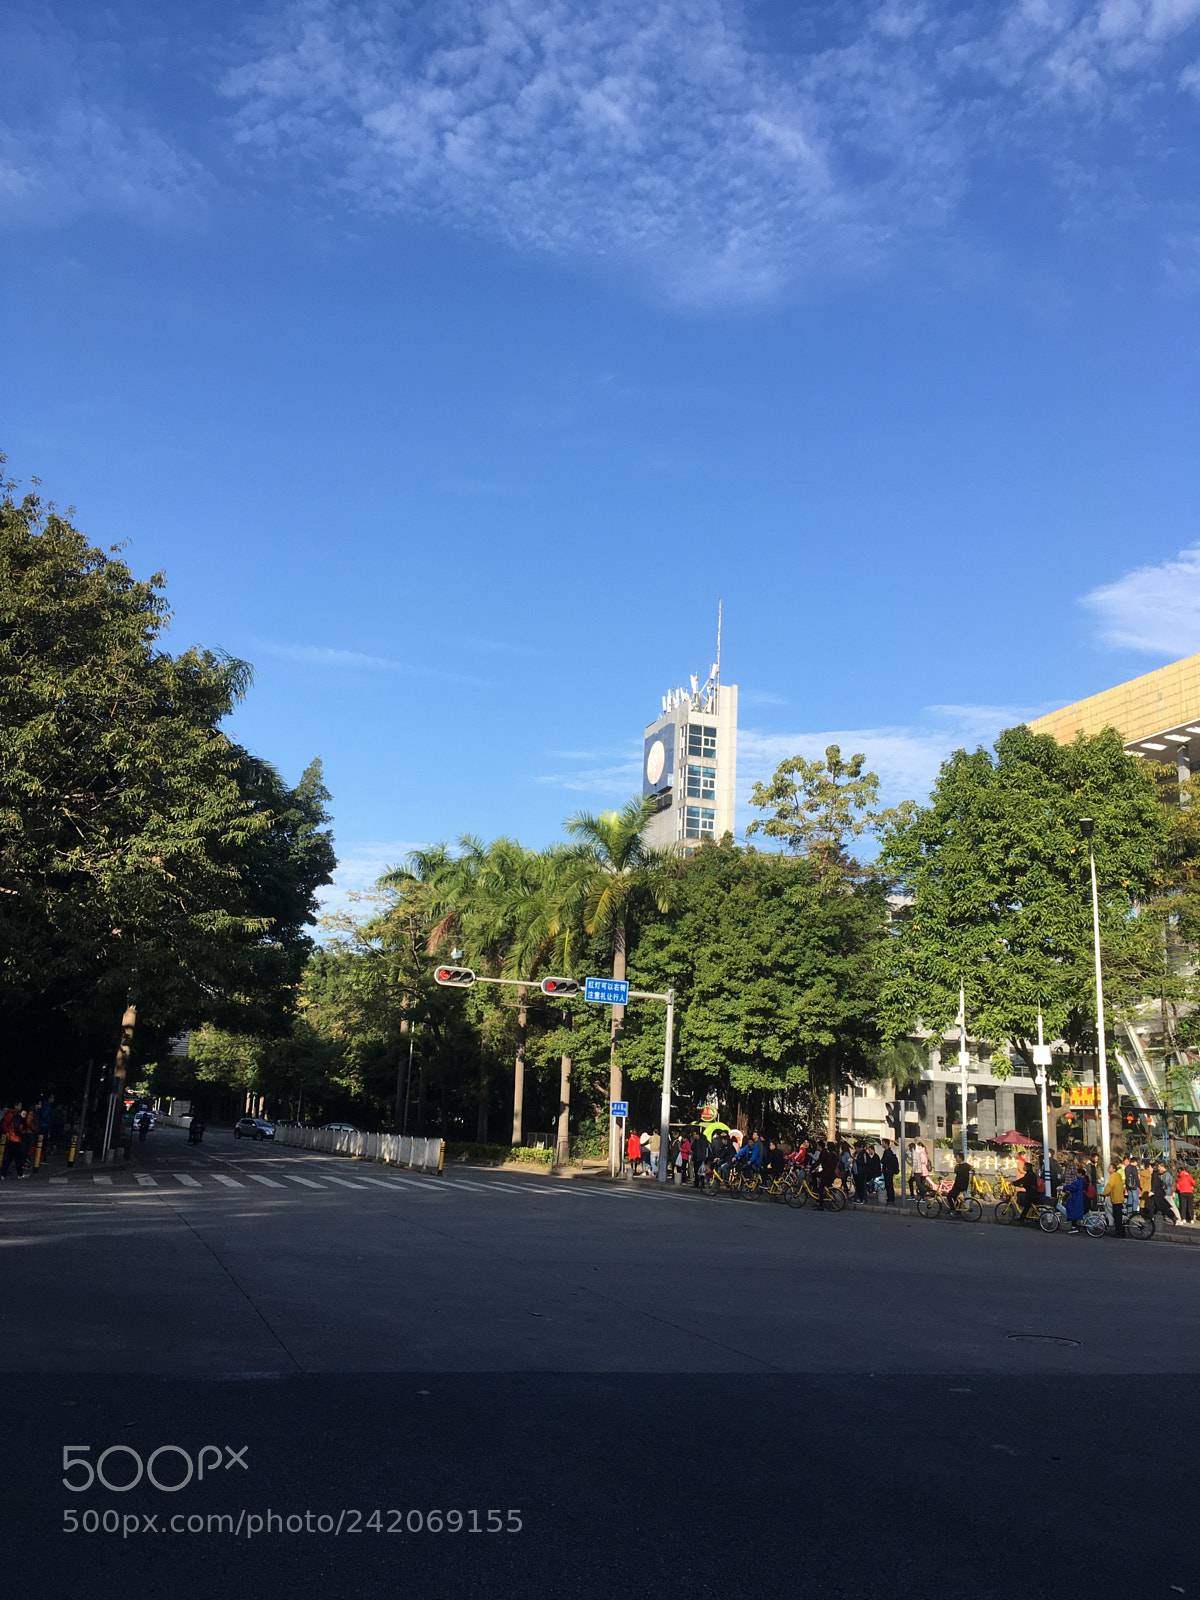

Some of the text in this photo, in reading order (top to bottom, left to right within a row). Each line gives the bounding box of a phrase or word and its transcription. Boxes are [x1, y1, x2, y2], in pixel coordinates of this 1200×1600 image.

[587, 991, 625, 1002] 注意礼让行人
